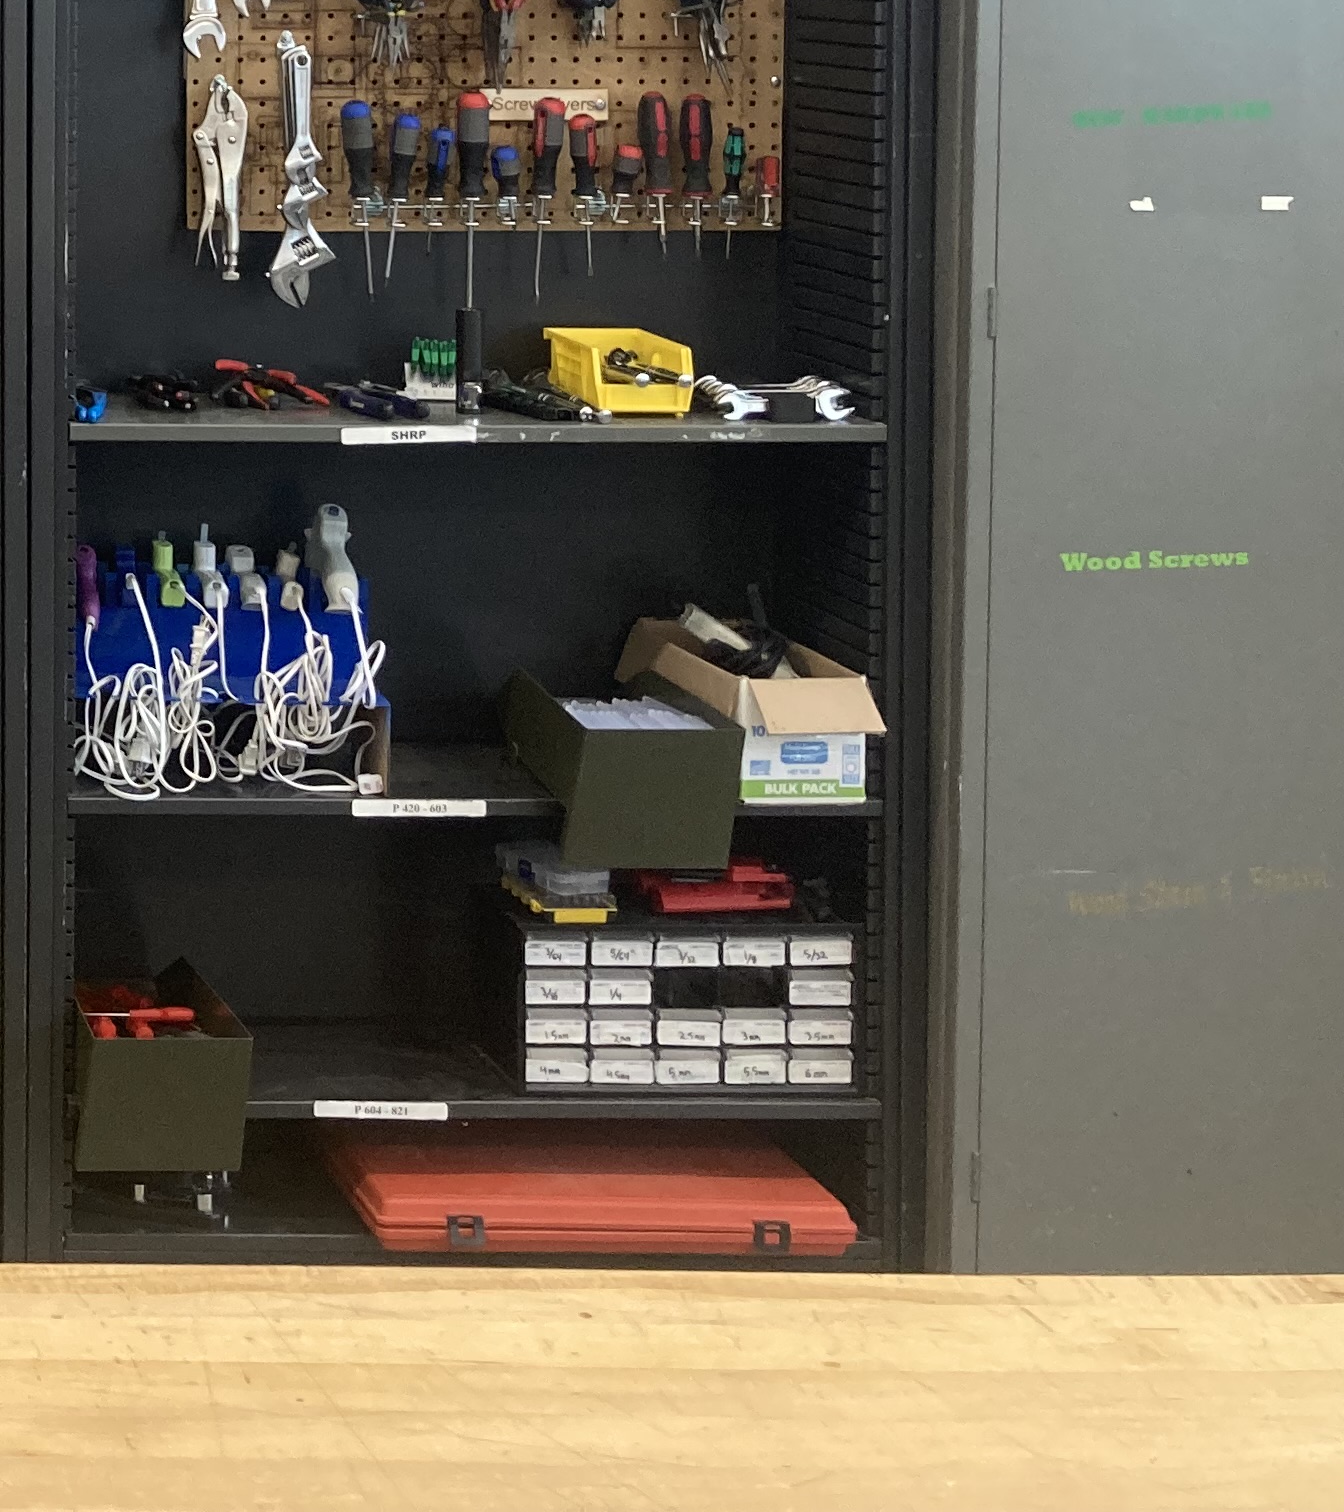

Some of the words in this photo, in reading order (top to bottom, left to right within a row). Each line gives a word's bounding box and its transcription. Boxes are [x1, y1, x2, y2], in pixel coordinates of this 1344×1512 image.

[492, 97, 596, 111] Screers
[392, 431, 426, 440] SHRP
[1060, 551, 1141, 571] Wood
[1149, 550, 1249, 569] Screws
[764, 782, 797, 794] BULK
[802, 782, 836, 794] PACK
[393, 804, 399, 813] P
[402, 804, 420, 813] 420
[429, 804, 447, 813] 603
[354, 1105, 361, 1114] P
[364, 1105, 382, 1114] 604
[392, 1106, 408, 1115] 821
